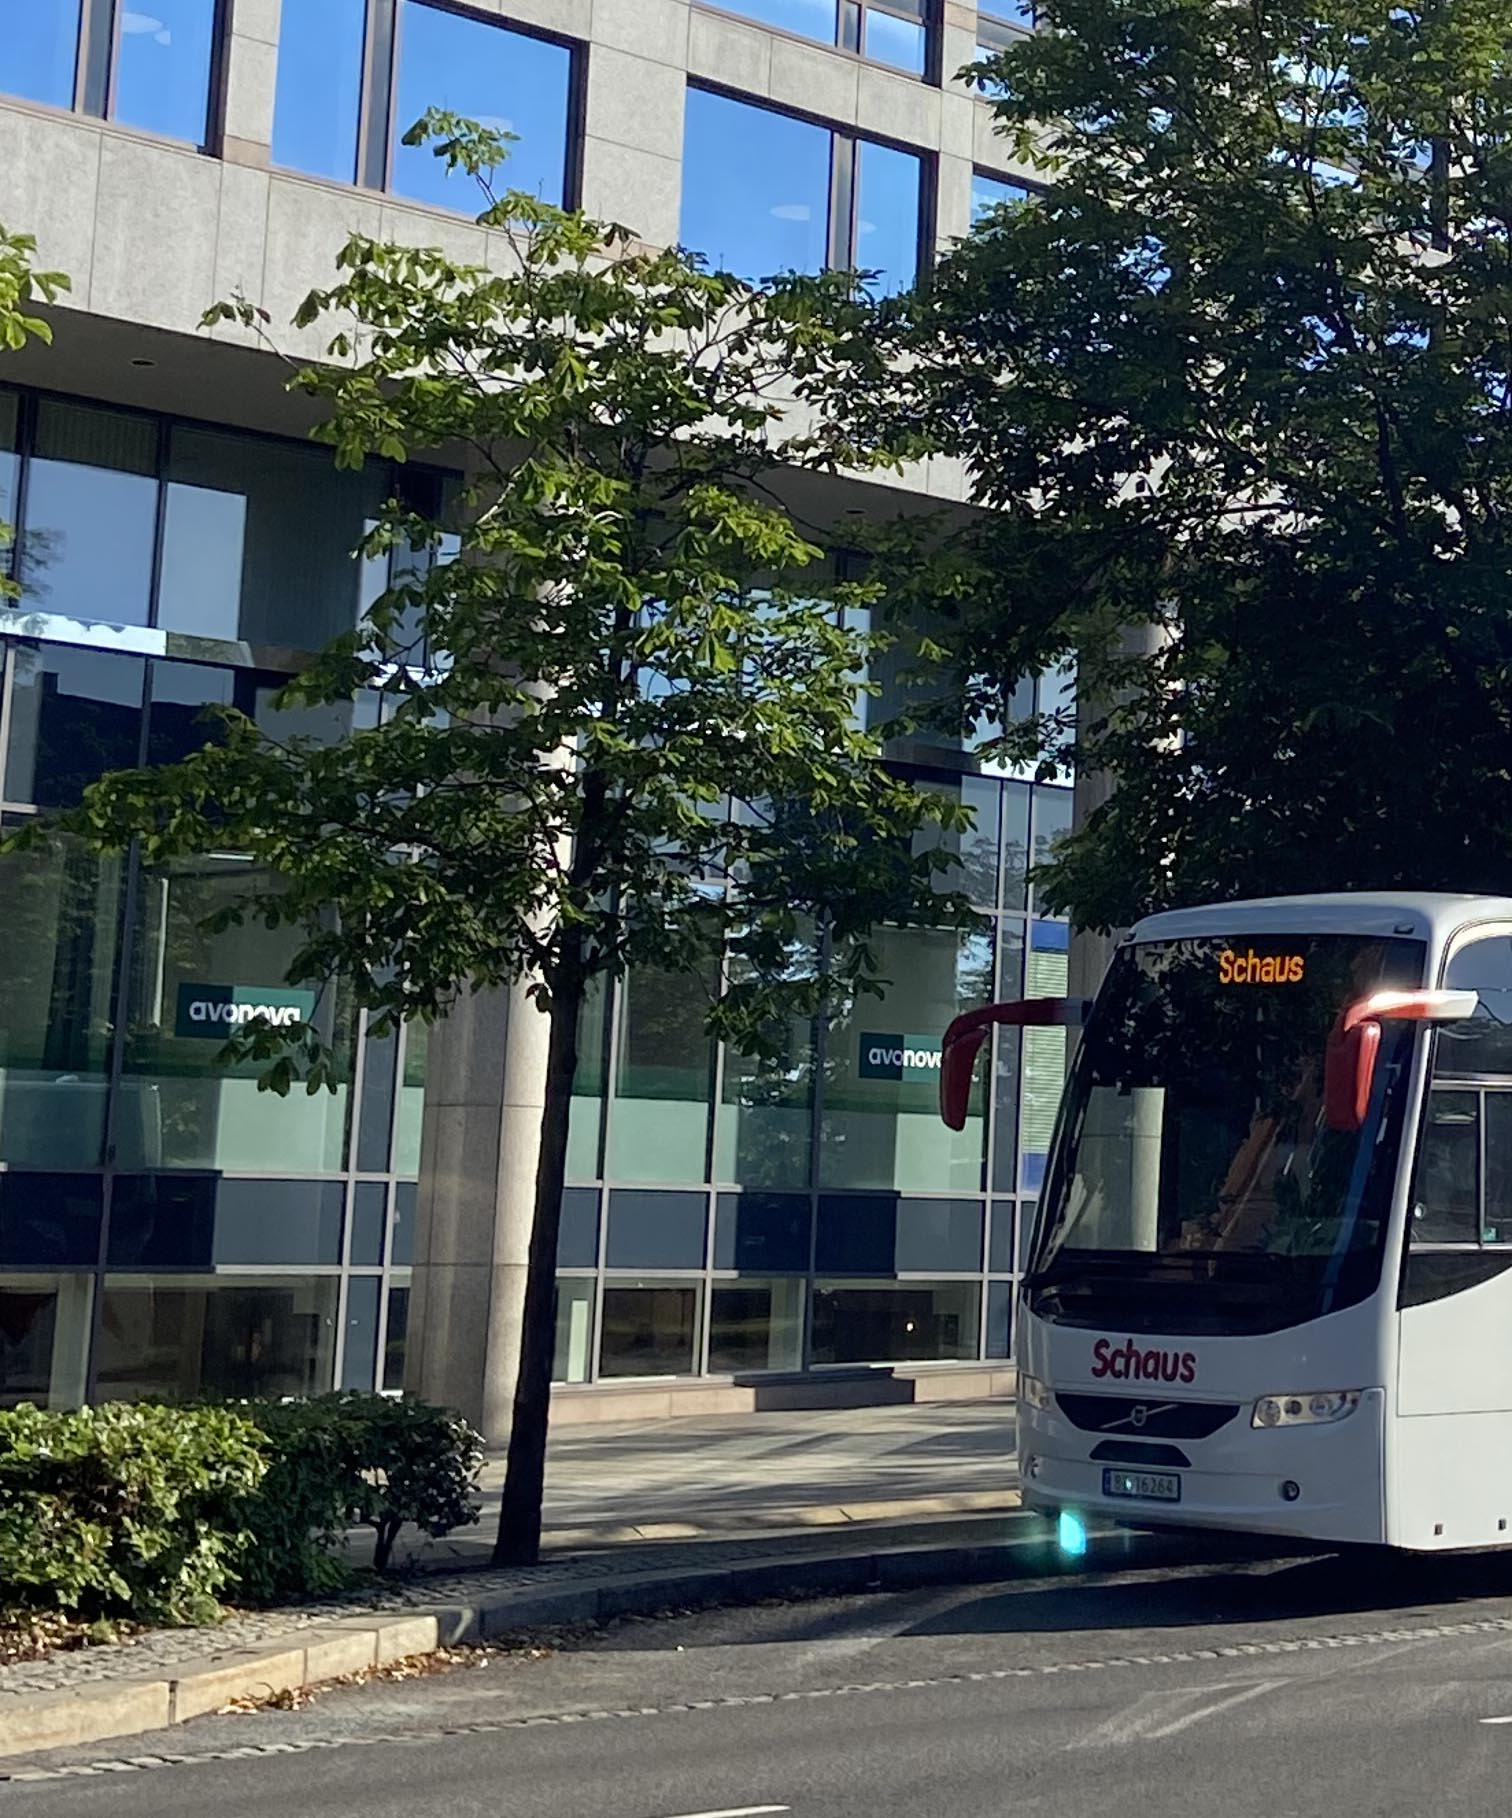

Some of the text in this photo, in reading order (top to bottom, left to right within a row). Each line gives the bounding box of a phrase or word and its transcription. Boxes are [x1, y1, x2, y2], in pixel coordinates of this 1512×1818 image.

[1219, 948, 1305, 984] Schaus
[868, 1047, 942, 1069] avonov
[1091, 1338, 1196, 1383] Schaus
